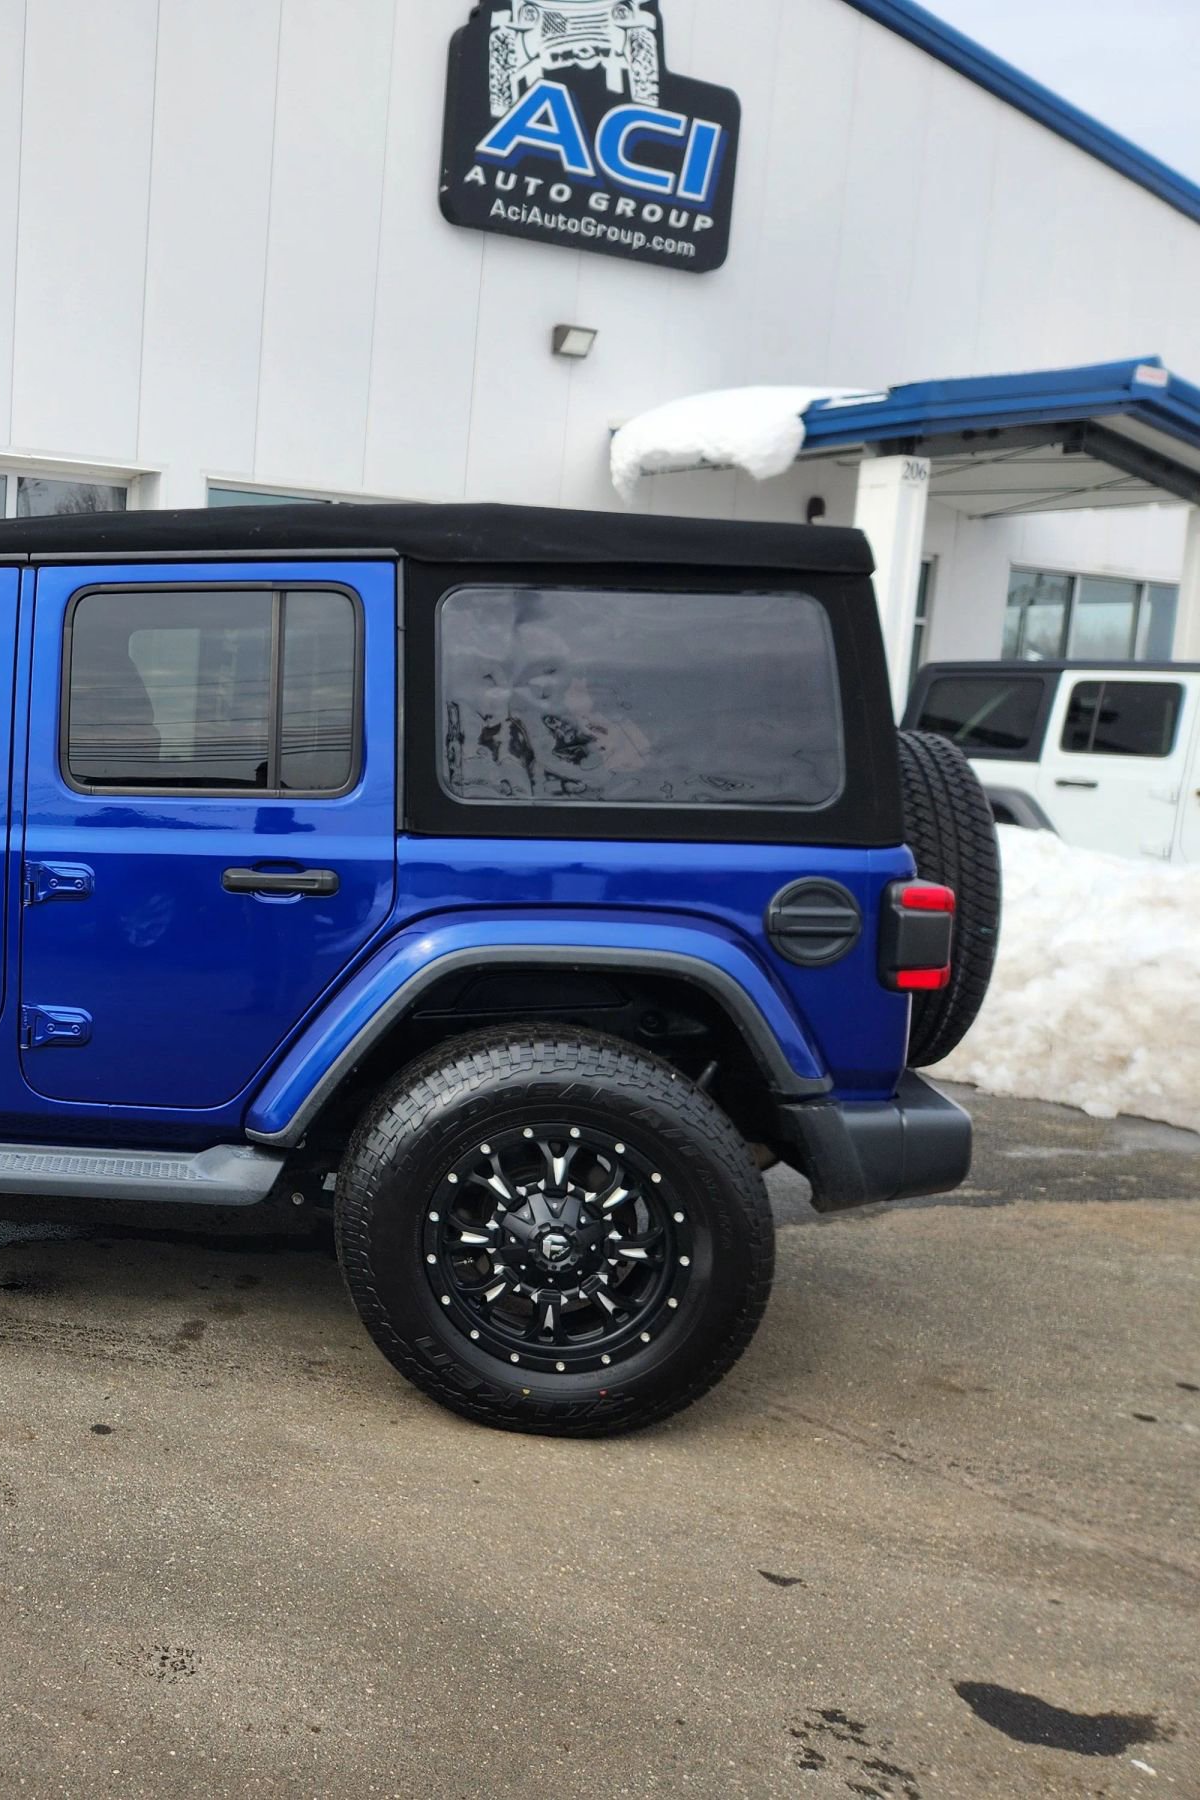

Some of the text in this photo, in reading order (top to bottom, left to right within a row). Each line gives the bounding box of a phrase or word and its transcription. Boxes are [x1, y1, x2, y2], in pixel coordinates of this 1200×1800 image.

[475, 77, 723, 203] ACI
[464, 165, 715, 233] AUTO GROUP
[489, 198, 696, 257] AciAutoGroup.com
[901, 460, 928, 481] 206
